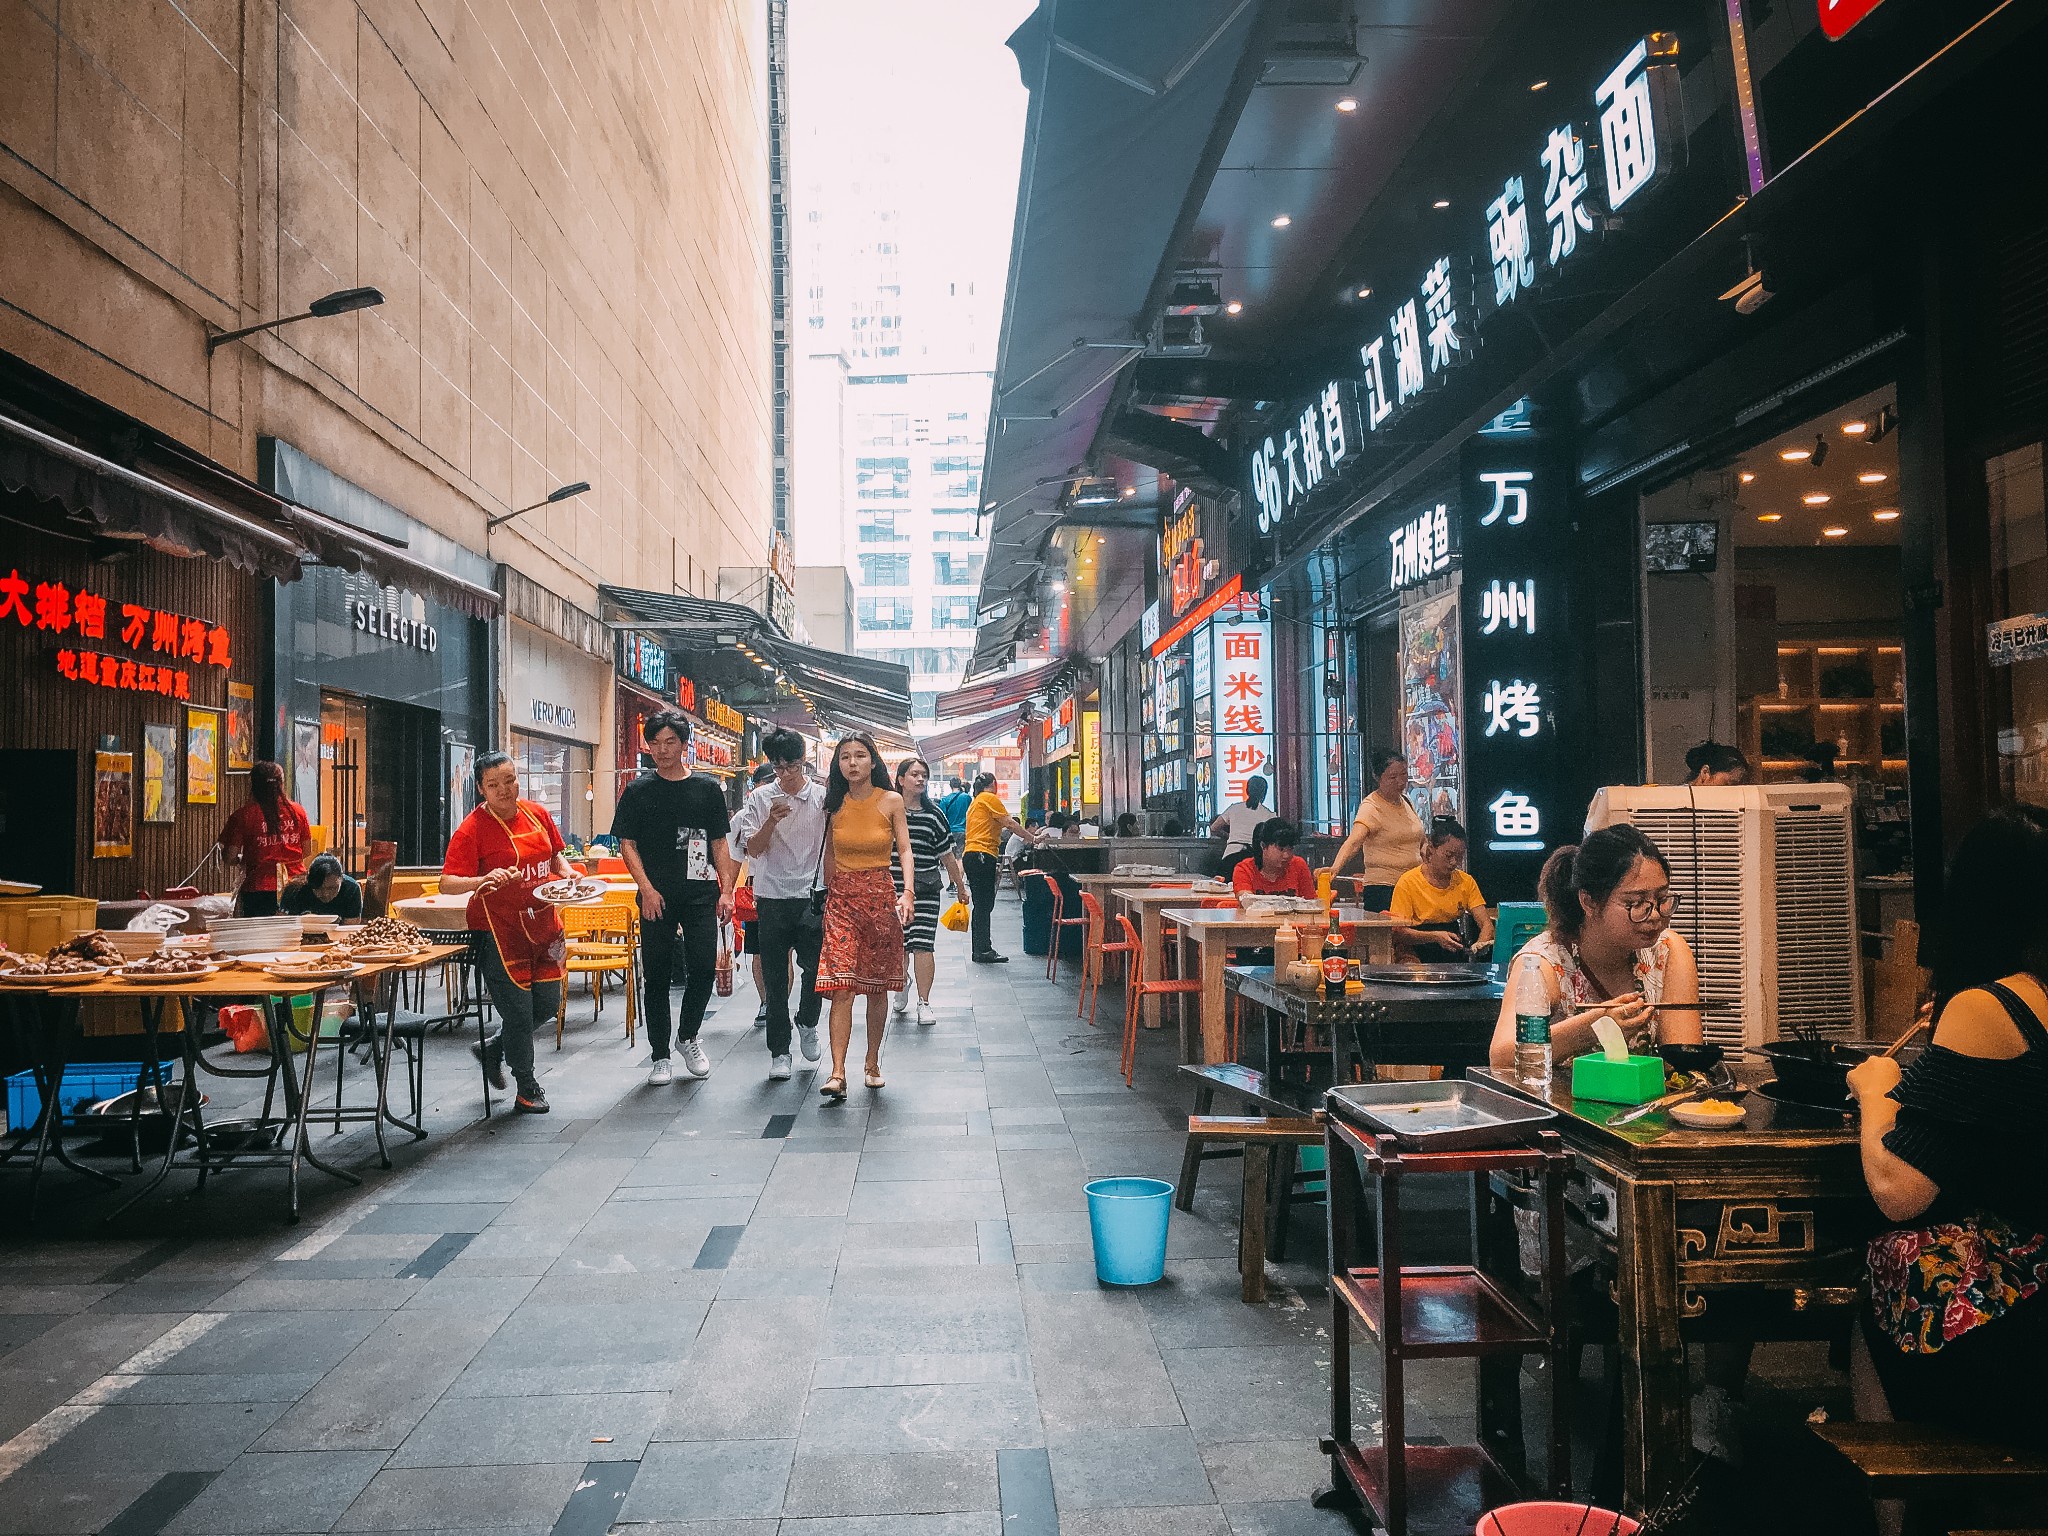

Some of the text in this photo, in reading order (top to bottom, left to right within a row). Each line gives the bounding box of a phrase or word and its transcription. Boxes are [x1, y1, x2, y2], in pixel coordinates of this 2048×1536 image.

[1361, 256, 1460, 432] 江湖菜
[1486, 38, 1656, 307] 豌杂面
[1389, 504, 1450, 591] 万州烤鱼
[0, 569, 232, 669] 大排档 万州烤鱼
[355, 600, 437, 652] SELECTED
[57, 649, 190, 700] 地道重庆江湖菜
[530, 698, 577, 729] VERO MODA
